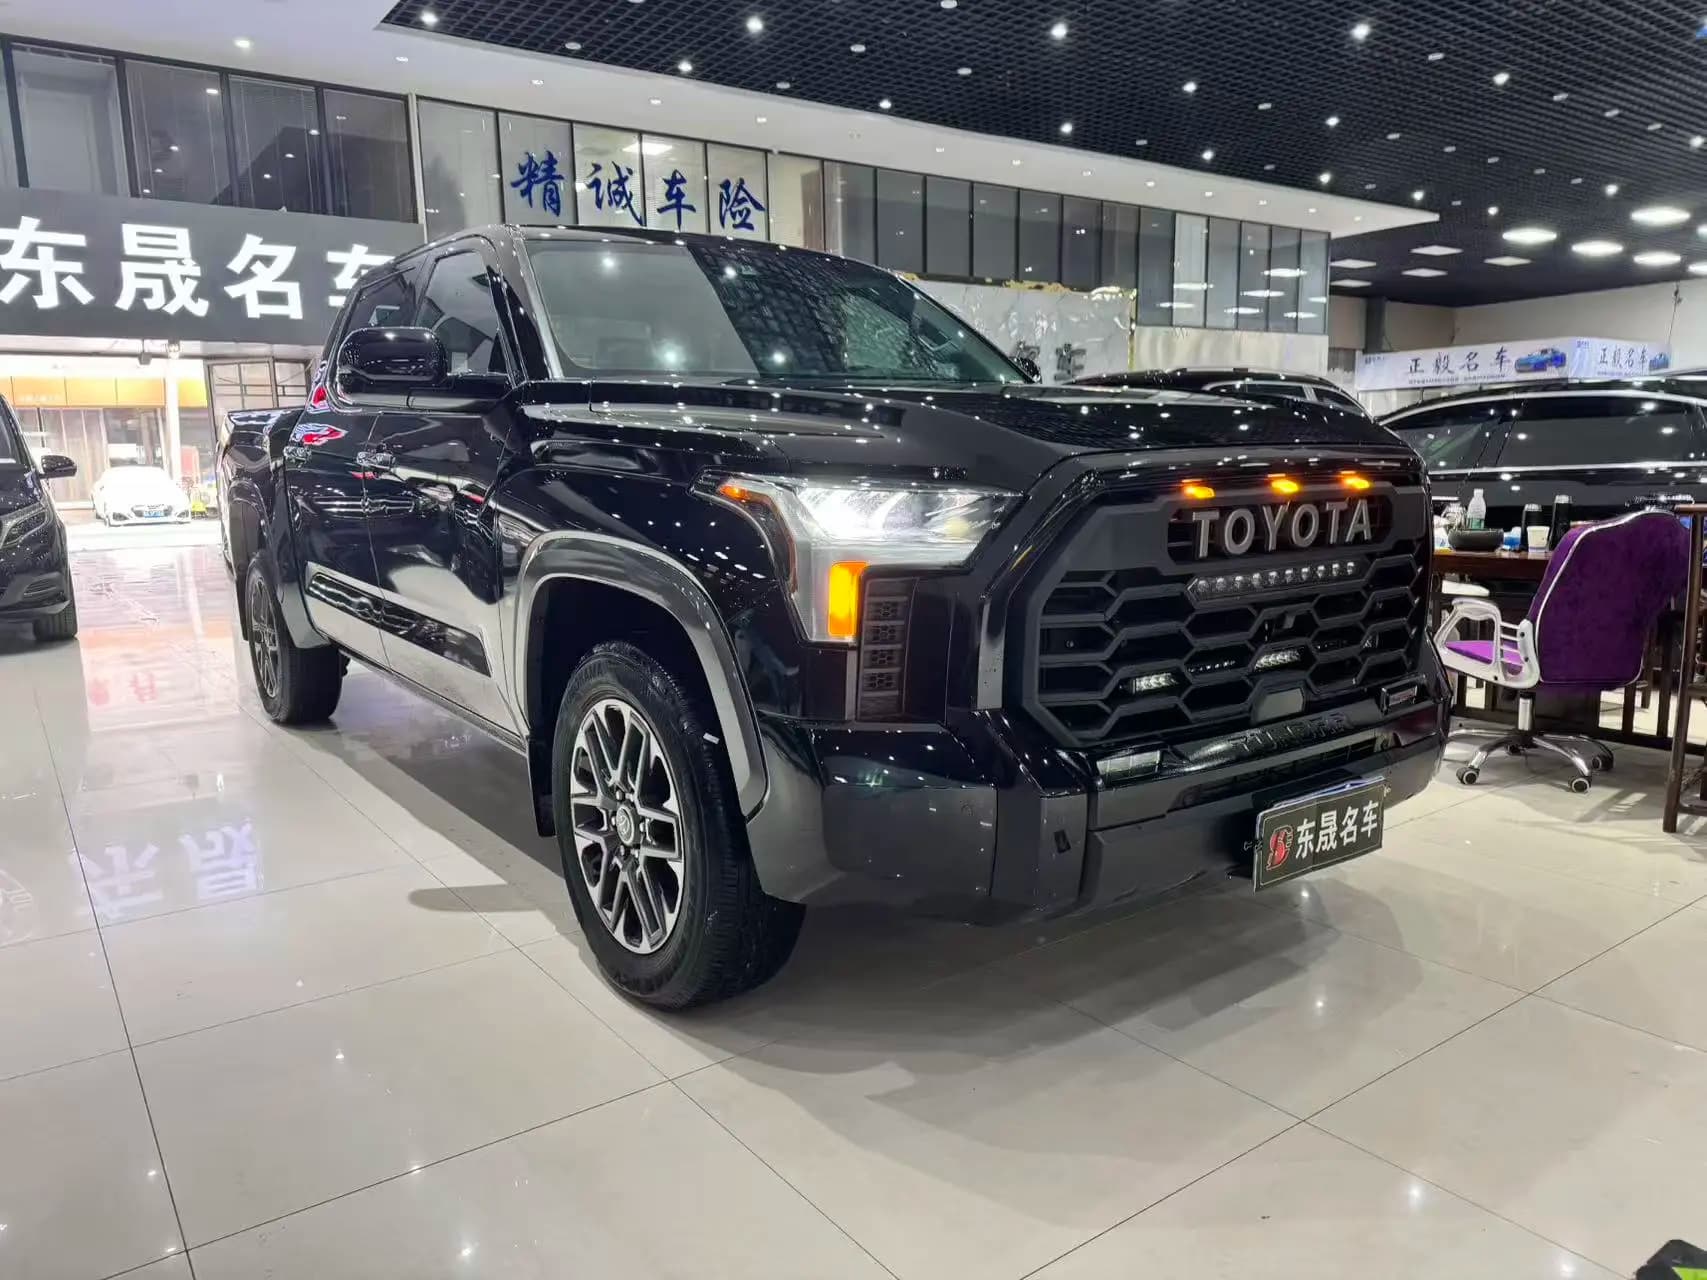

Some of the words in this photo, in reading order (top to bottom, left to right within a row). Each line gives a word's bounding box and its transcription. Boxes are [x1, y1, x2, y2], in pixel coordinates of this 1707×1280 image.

[510, 151, 765, 230] 精诚车险
[1192, 499, 1372, 559] TOYOTA
[1295, 800, 1379, 859] 东晟名车
